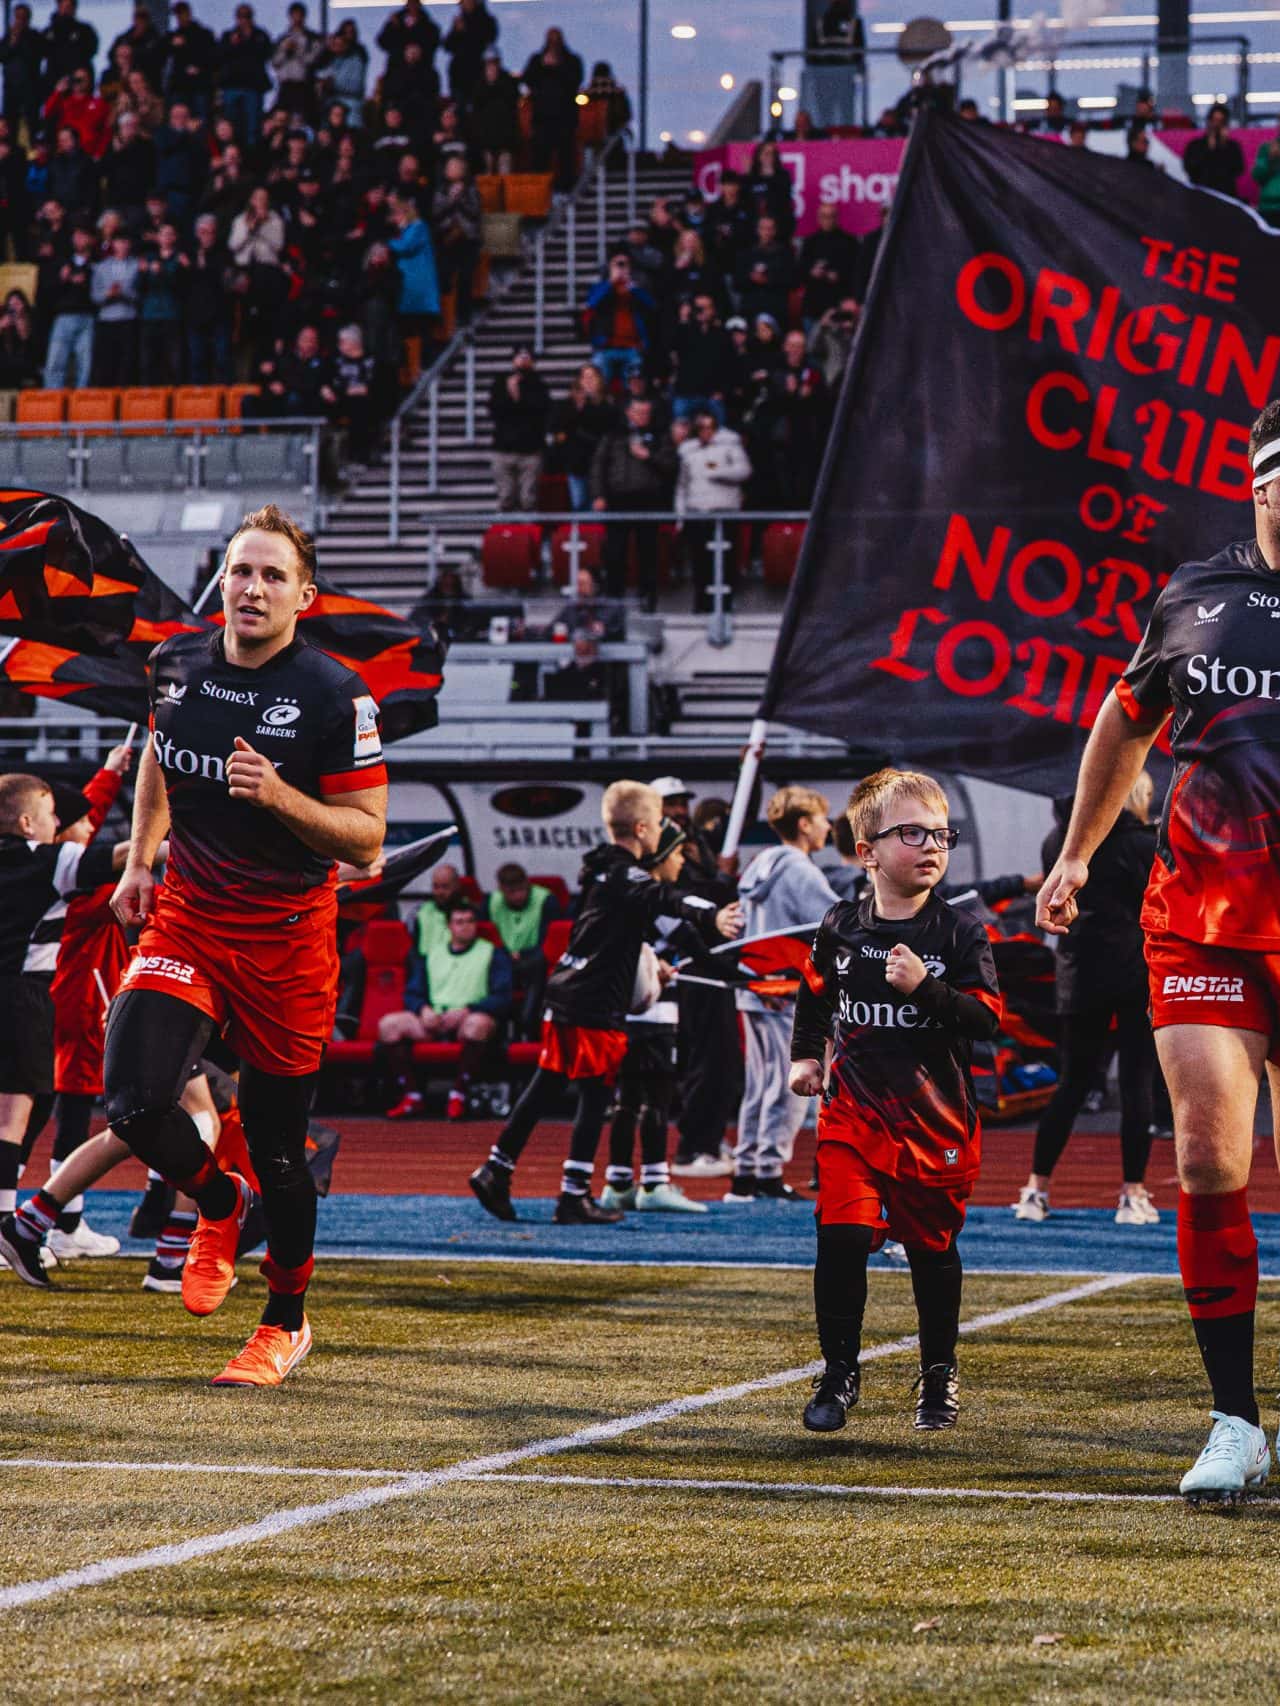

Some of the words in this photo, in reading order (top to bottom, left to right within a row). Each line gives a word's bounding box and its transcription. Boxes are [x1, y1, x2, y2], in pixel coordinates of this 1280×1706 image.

[1140, 236, 1240, 302] THE
[1026, 371, 1256, 501] CLUB
[1079, 483, 1168, 544] OF
[199, 680, 260, 706] StoneX
[255, 724, 297, 739] SARACENS
[1163, 975, 1244, 994] ENSTAR
